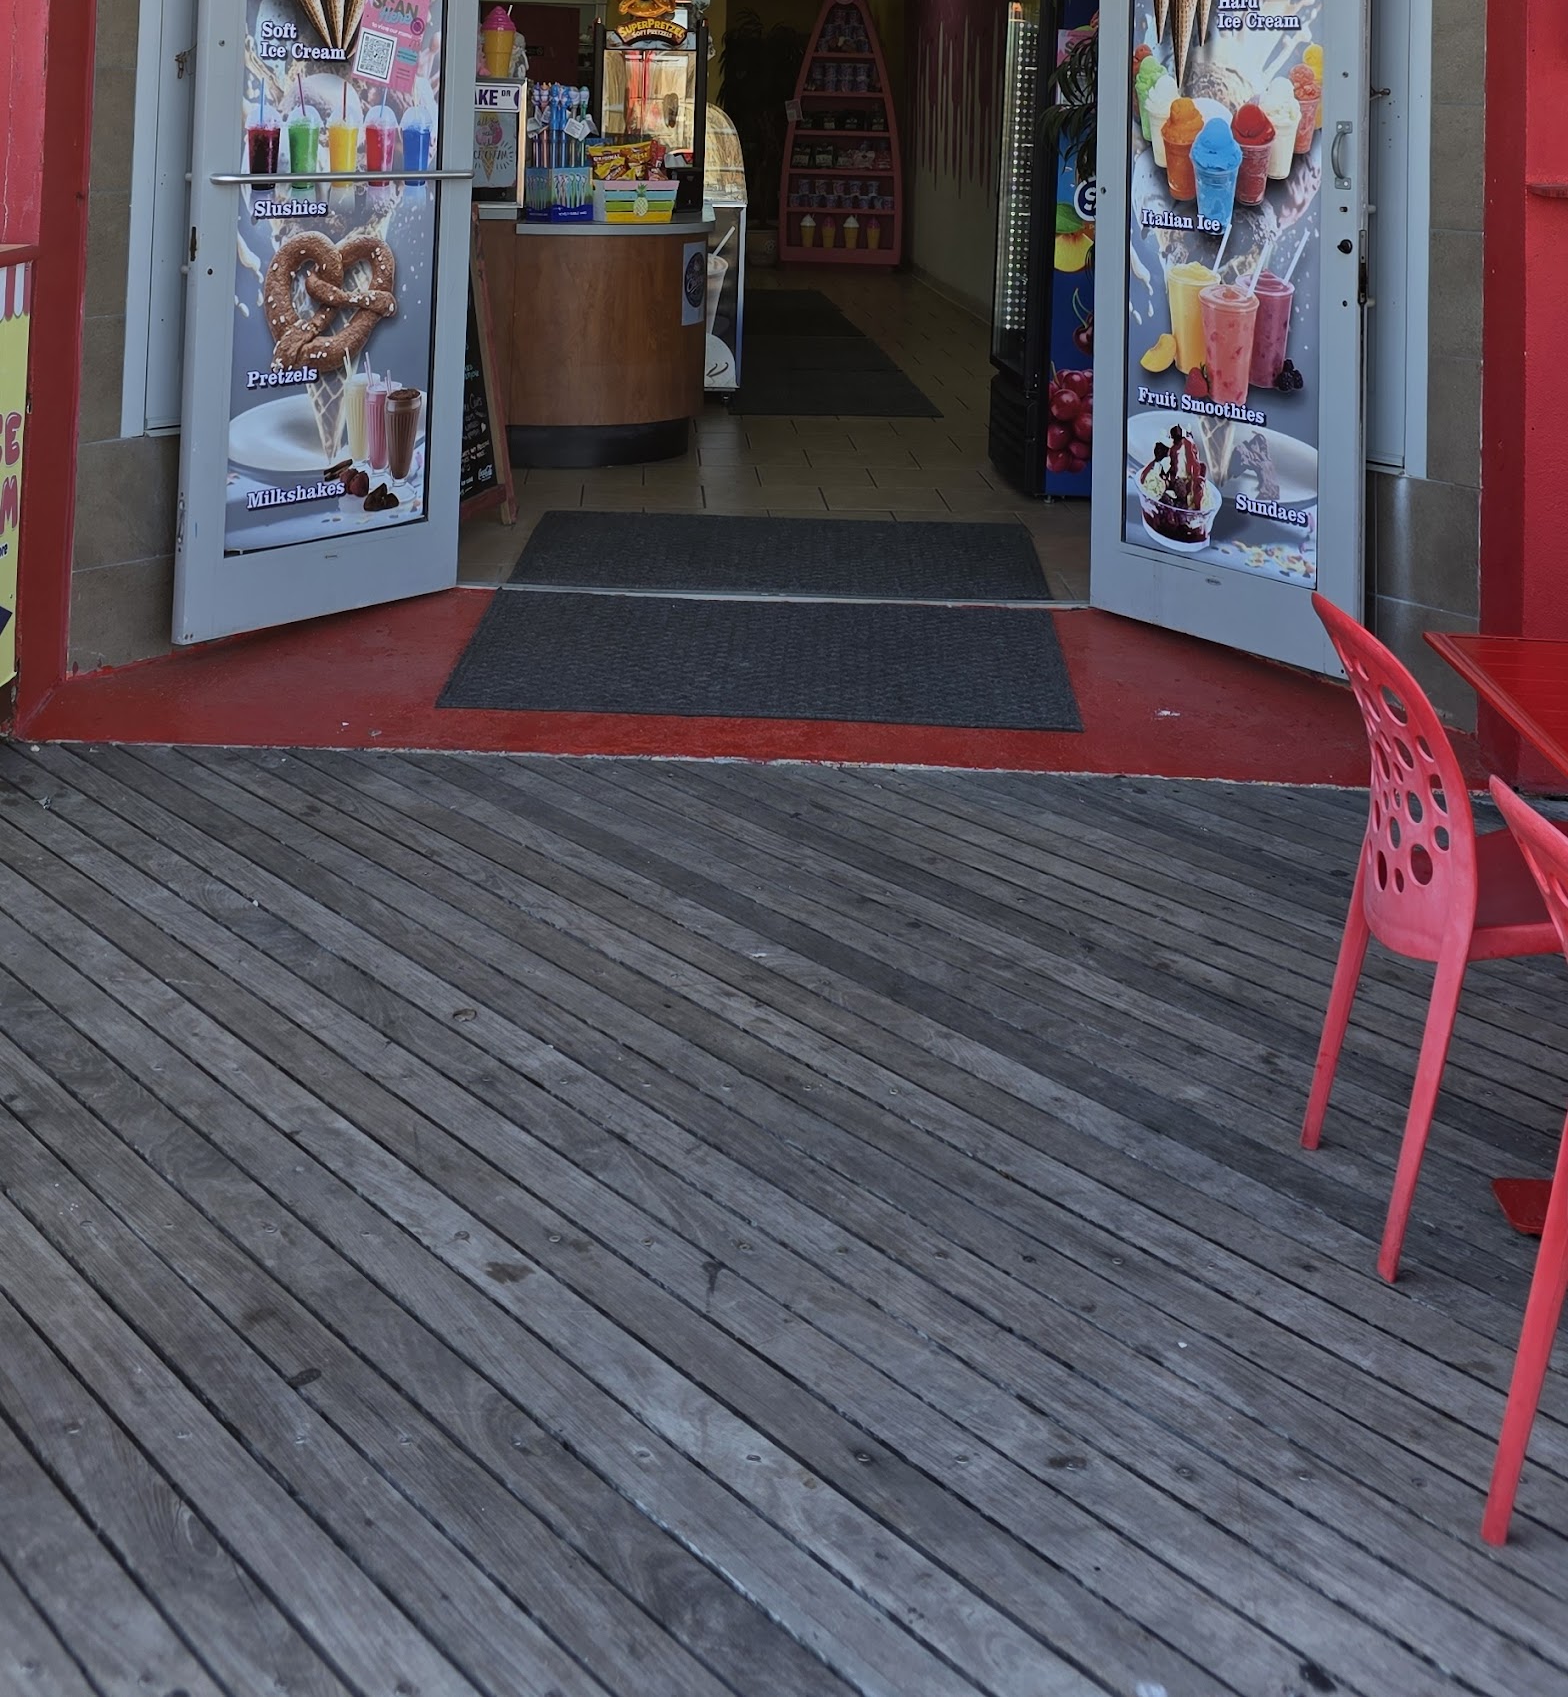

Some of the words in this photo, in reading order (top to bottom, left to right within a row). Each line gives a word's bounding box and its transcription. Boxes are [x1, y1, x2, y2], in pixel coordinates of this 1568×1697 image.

[260, 21, 297, 40] Soft
[1217, 12, 1244, 30] Ice
[1245, 13, 1300, 30] Cream
[260, 42, 288, 60] Ice
[291, 42, 346, 61] Cream
[475, 89, 499, 106] KE
[253, 199, 328, 219] Slushies
[1141, 208, 1194, 230] Italian
[1196, 214, 1222, 232] Ice
[246, 366, 318, 389] Pretzels
[1137, 386, 1177, 410] Fruit
[1180, 393, 1265, 424] Smoothies
[246, 480, 346, 511] Milkshakes
[1235, 493, 1308, 525] Sundaes
